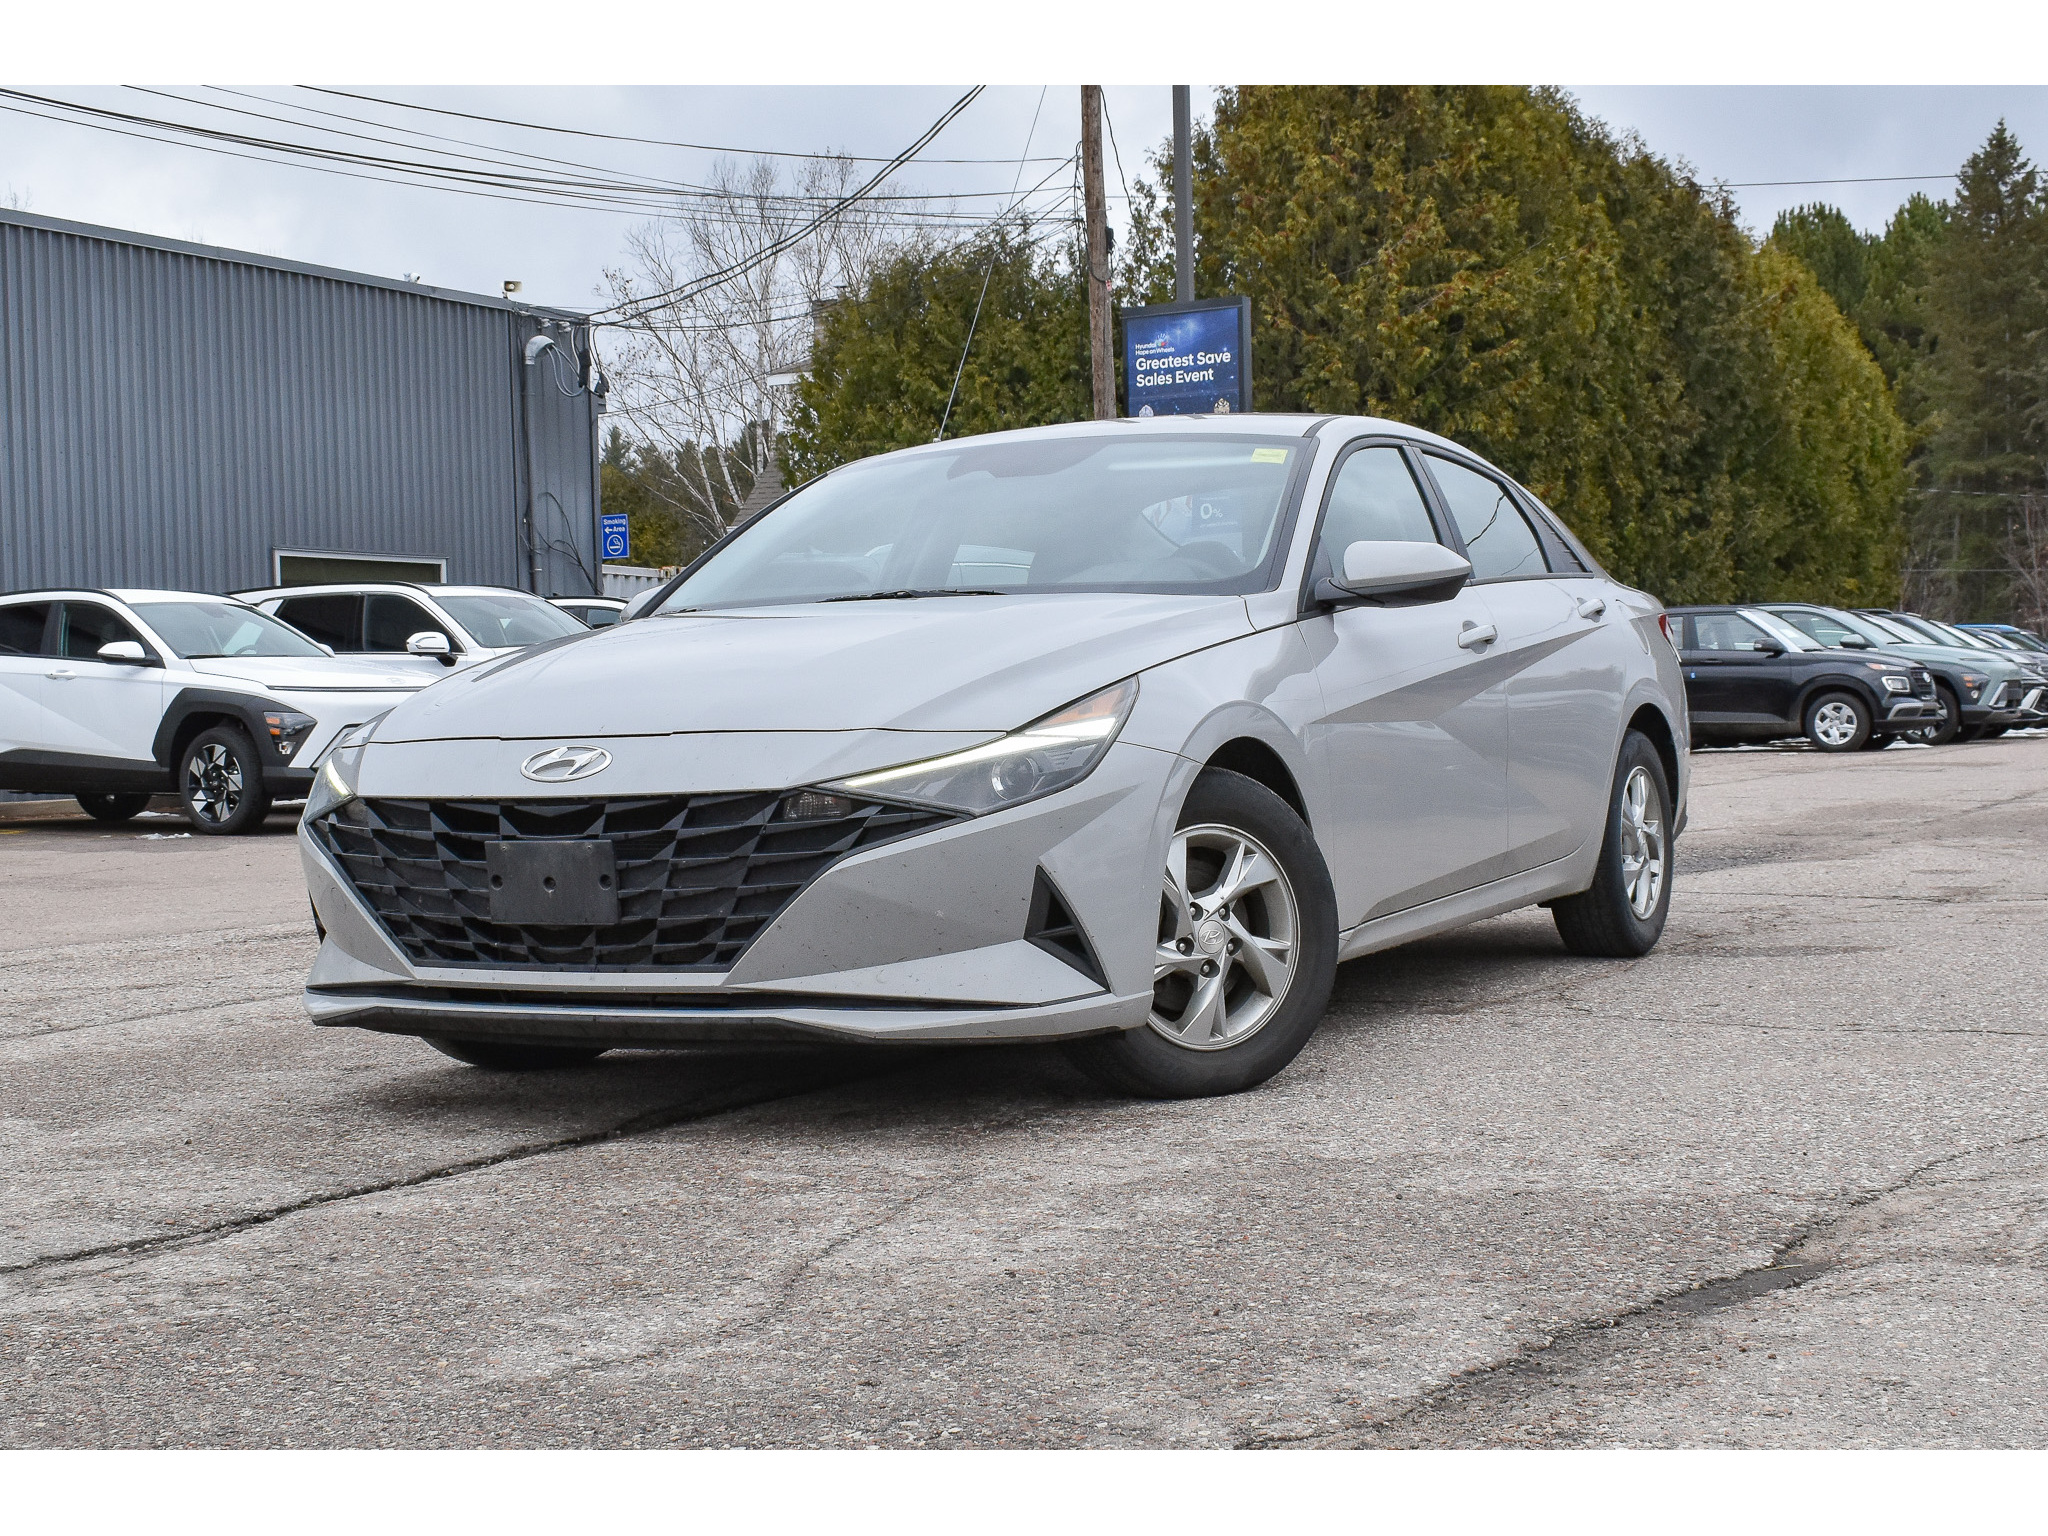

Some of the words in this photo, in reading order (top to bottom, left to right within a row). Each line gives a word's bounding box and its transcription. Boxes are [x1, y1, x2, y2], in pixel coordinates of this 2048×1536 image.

[1135, 342, 1156, 350] Hyundai
[1157, 346, 1175, 354] Wheels
[1136, 354, 1194, 371] Greatest
[1197, 351, 1231, 365] Save
[1136, 372, 1172, 387] Sales
[1175, 368, 1214, 384] Event
[1200, 503, 1223, 519] 0%
